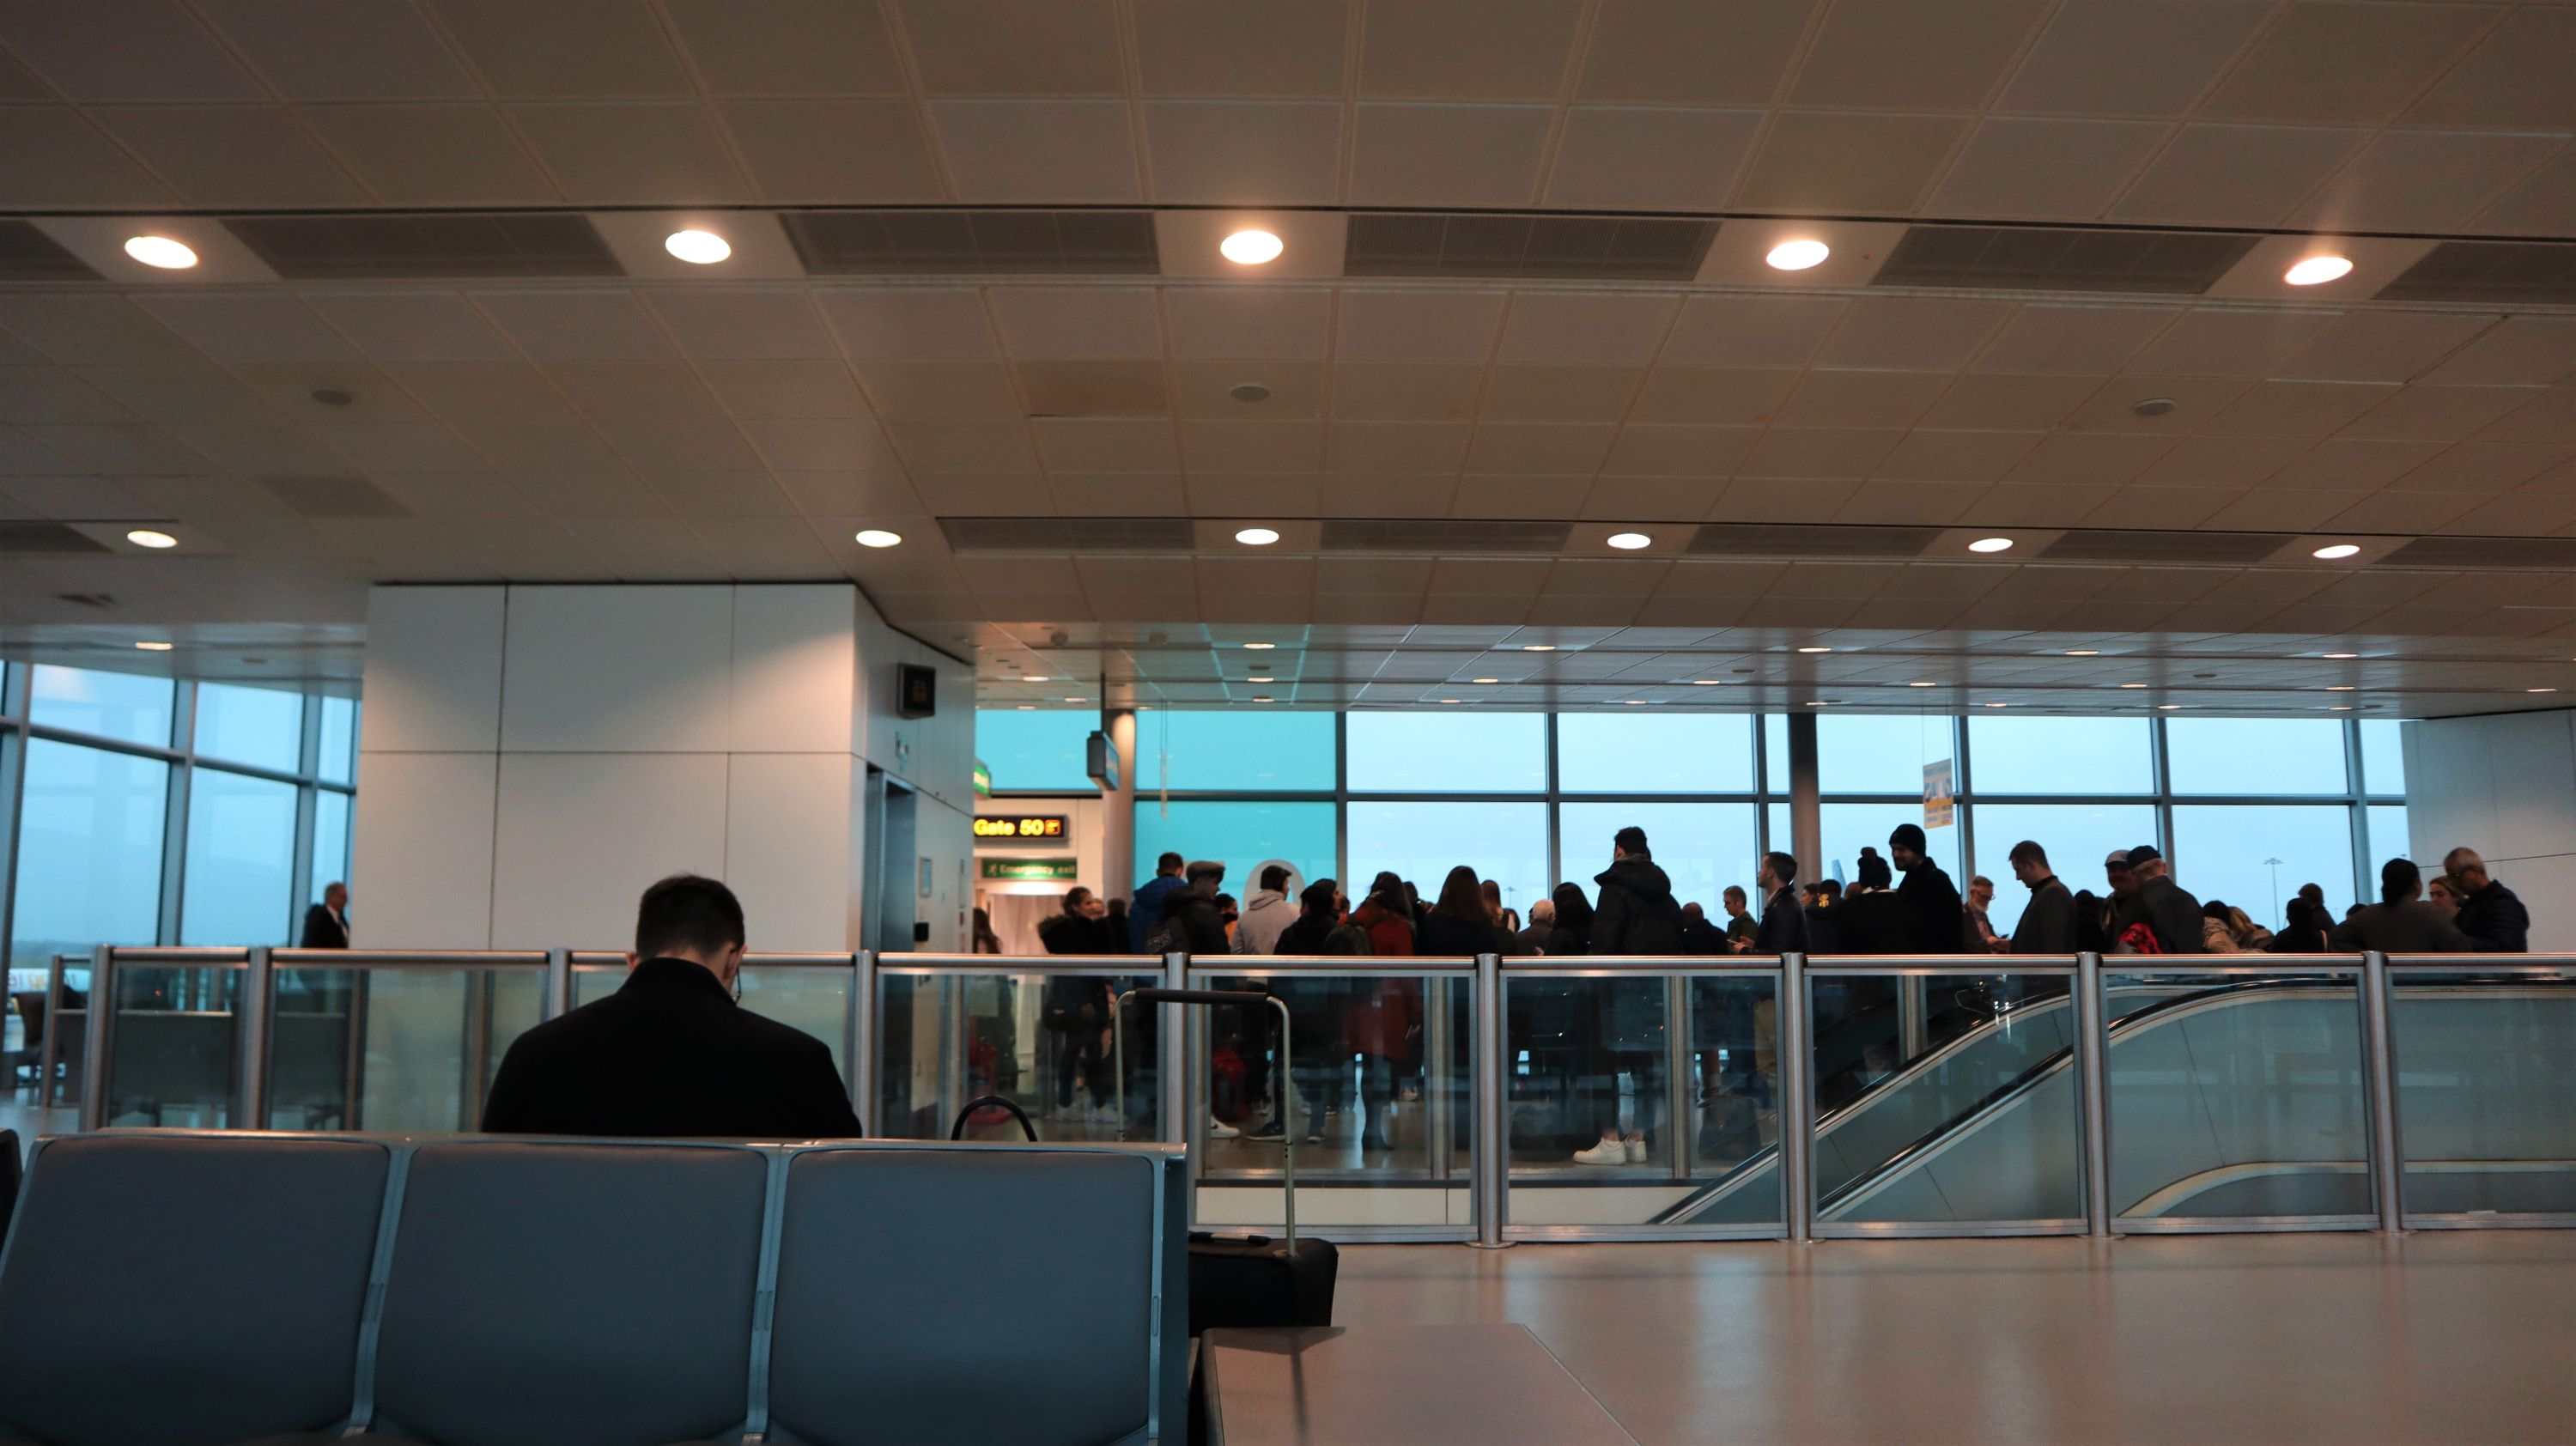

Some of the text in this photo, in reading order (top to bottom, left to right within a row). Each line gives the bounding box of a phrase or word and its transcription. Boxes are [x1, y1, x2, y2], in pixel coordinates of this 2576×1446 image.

[974, 819, 1044, 835] Gate 50
[999, 865, 1076, 875] Emergency exit
